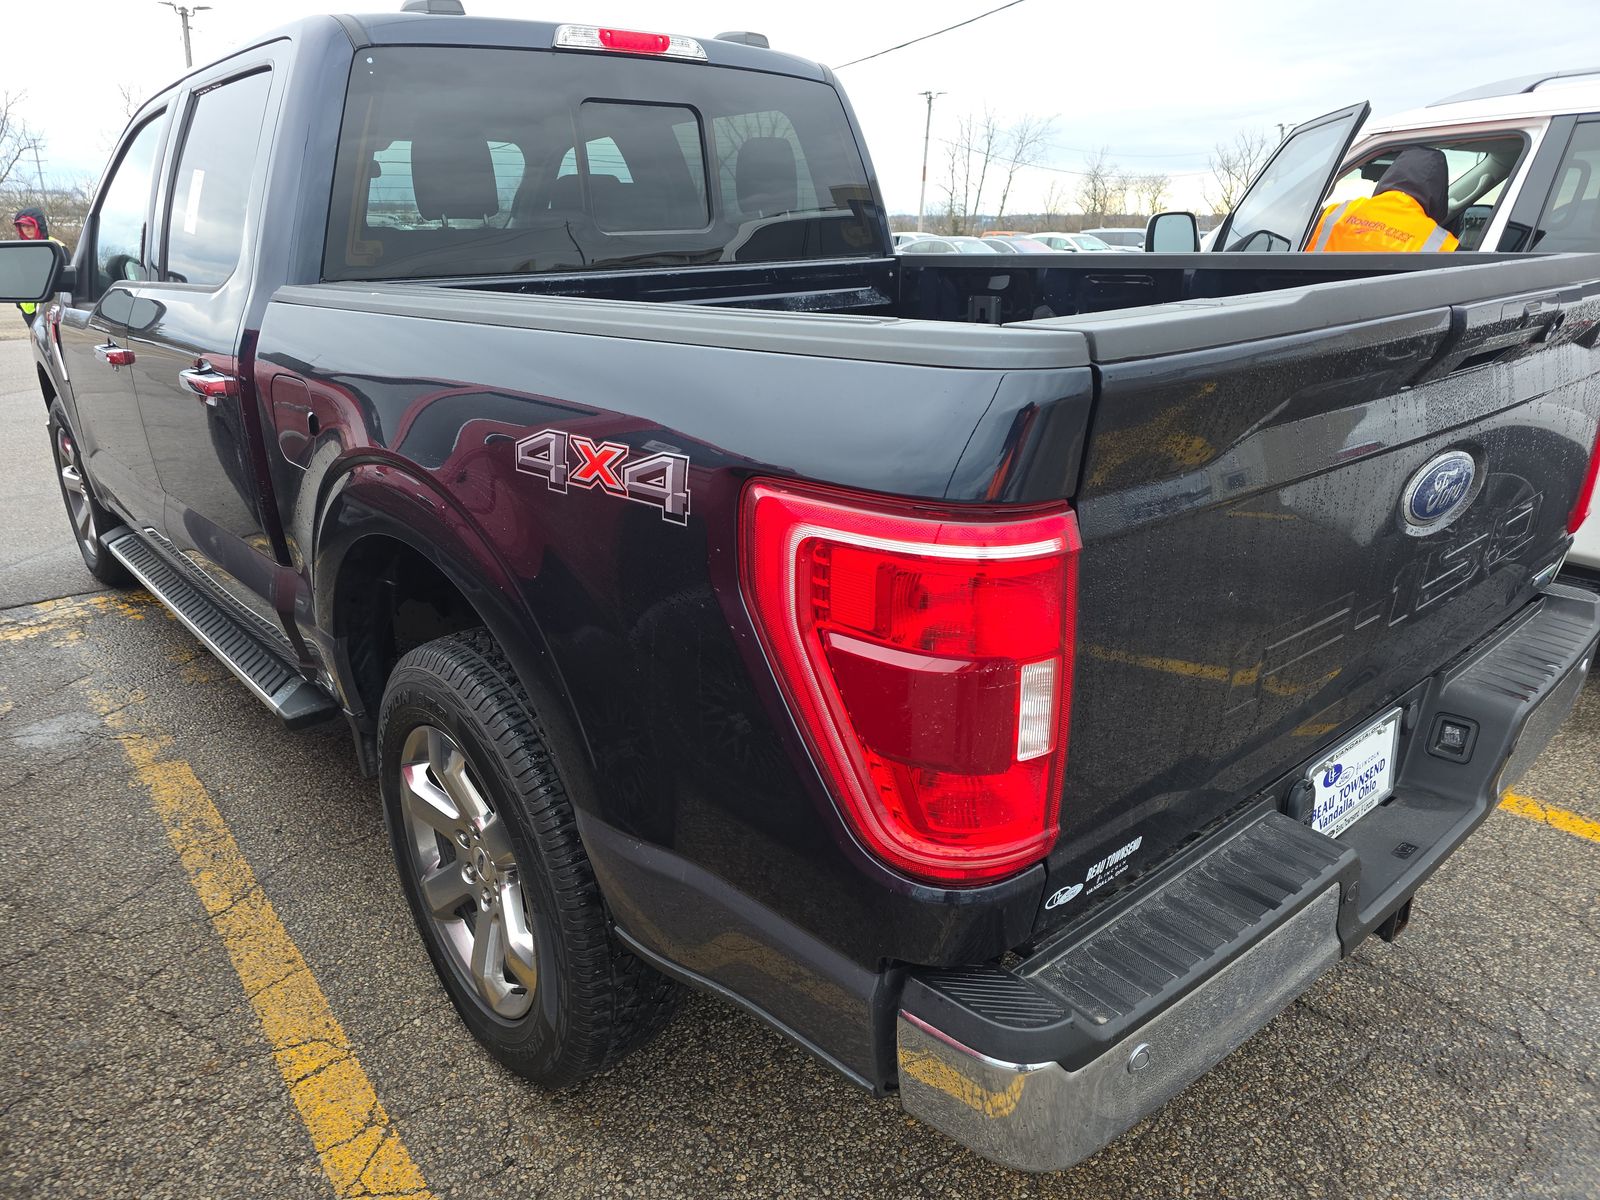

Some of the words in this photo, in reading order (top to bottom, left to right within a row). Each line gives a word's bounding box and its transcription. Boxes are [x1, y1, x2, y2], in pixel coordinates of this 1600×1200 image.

[1427, 467, 1468, 514] Ford
[1311, 795, 1335, 822] BEAU
[1340, 758, 1385, 802] TOWNSEND
[1358, 780, 1377, 800] Ohio
[1085, 858, 1107, 882] BEAU
[1105, 835, 1143, 870] TOWNSEND
[1114, 864, 1129, 877] OHIO
